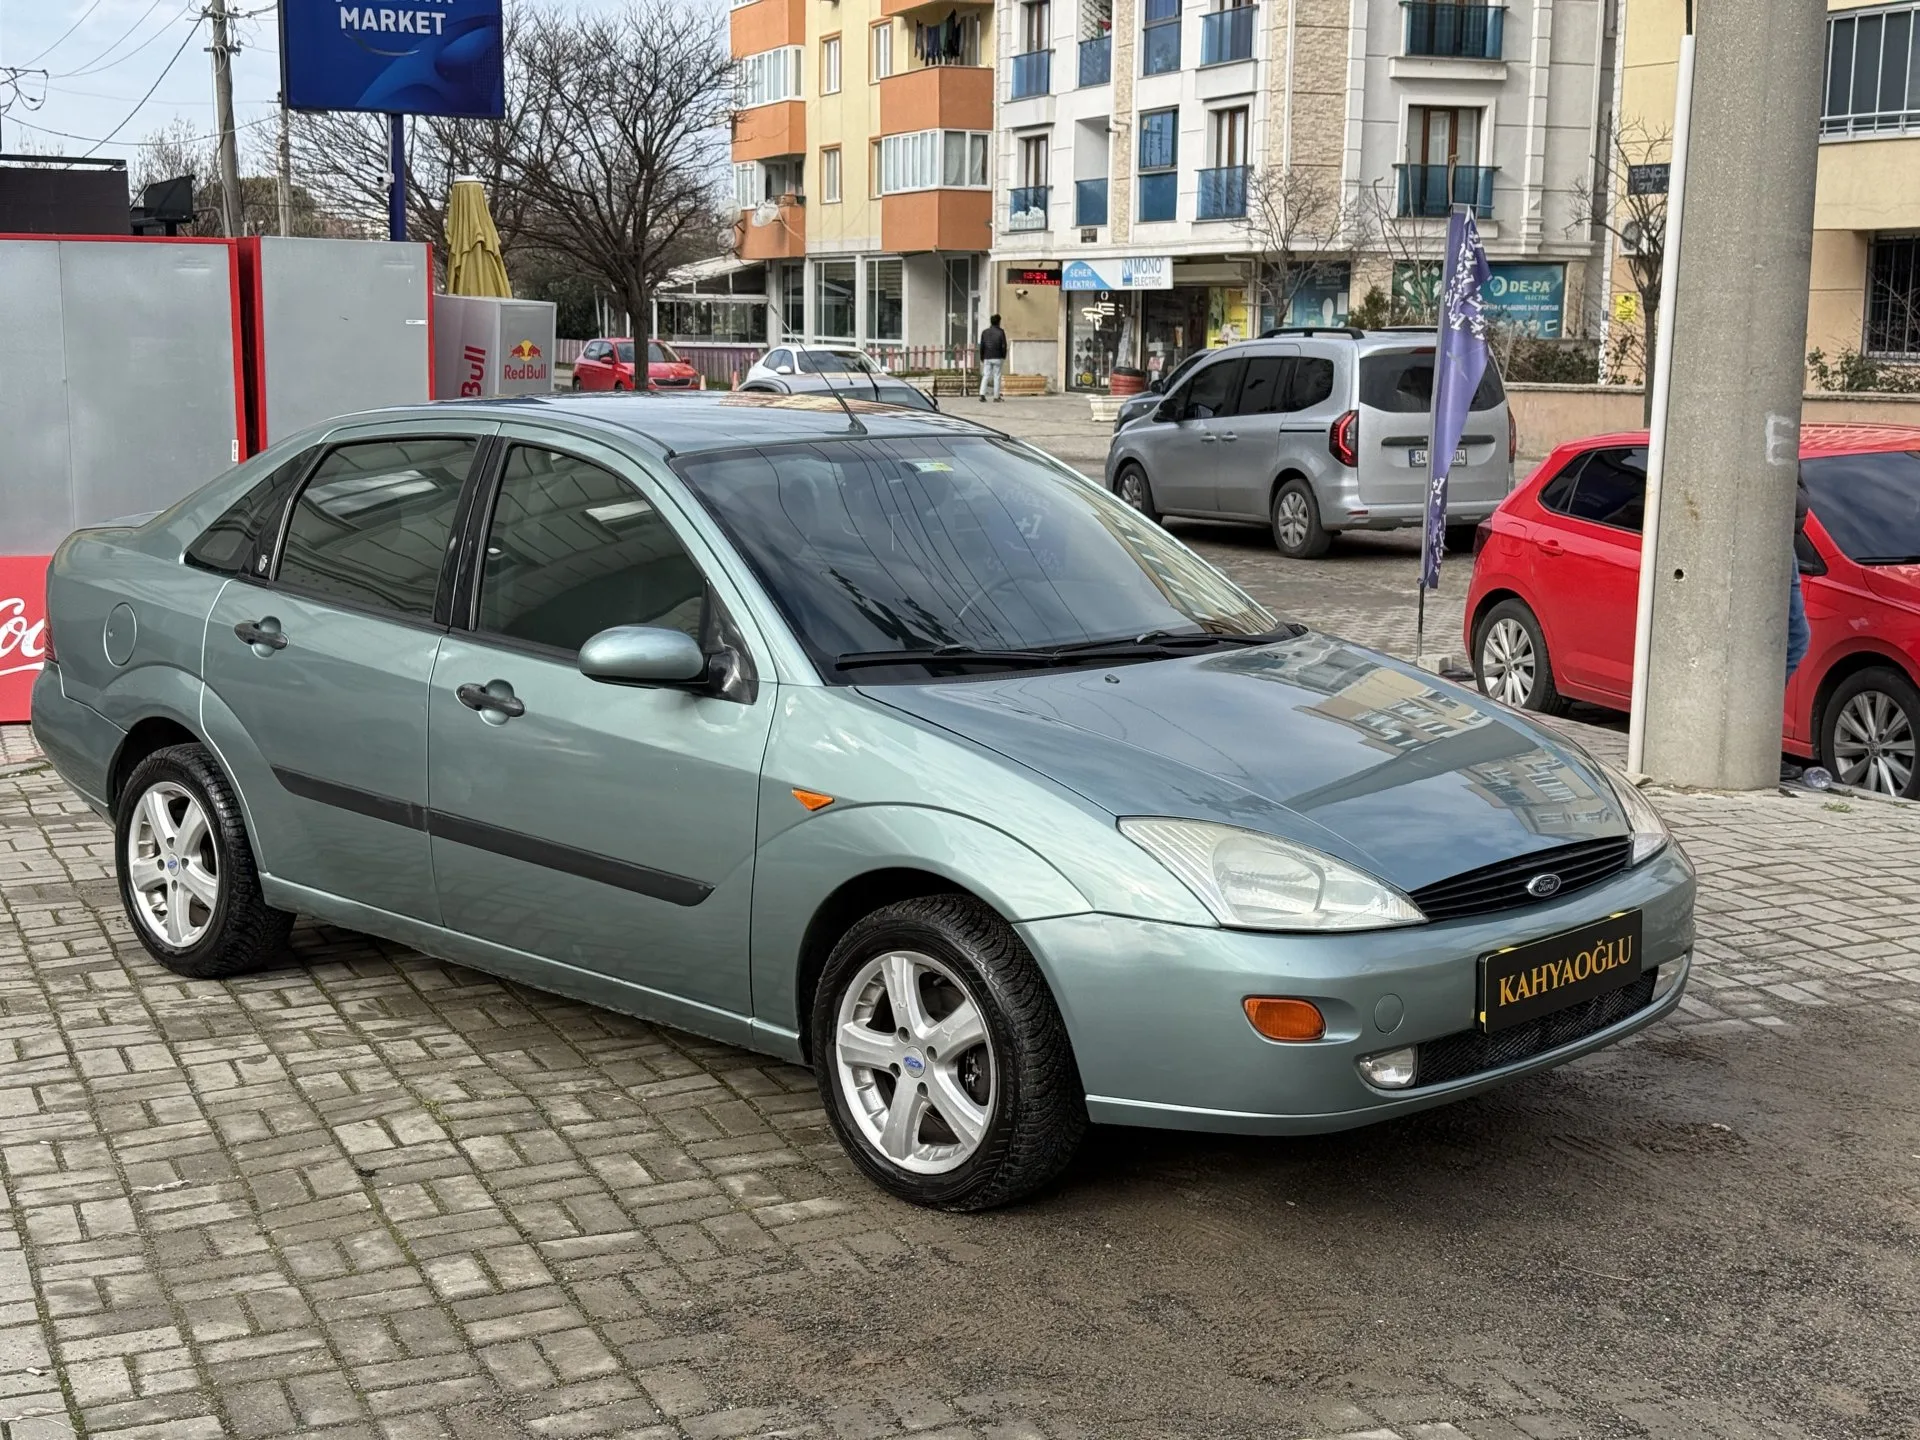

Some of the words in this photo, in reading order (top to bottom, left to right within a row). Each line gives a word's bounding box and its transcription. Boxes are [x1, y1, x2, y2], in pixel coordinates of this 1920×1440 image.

[340, 6, 446, 35] MARKET
[1134, 258, 1162, 274] MONO
[1070, 269, 1092, 278] SEHER
[1134, 276, 1162, 287] ELECTRIC
[1509, 280, 1550, 293] DE-PA
[504, 364, 525, 380] Red
[527, 363, 547, 379] Bull
[1416, 450, 1426, 462] 34
[1538, 878, 1556, 892] Ford
[1498, 934, 1633, 1007] KAHYAOĞLU
